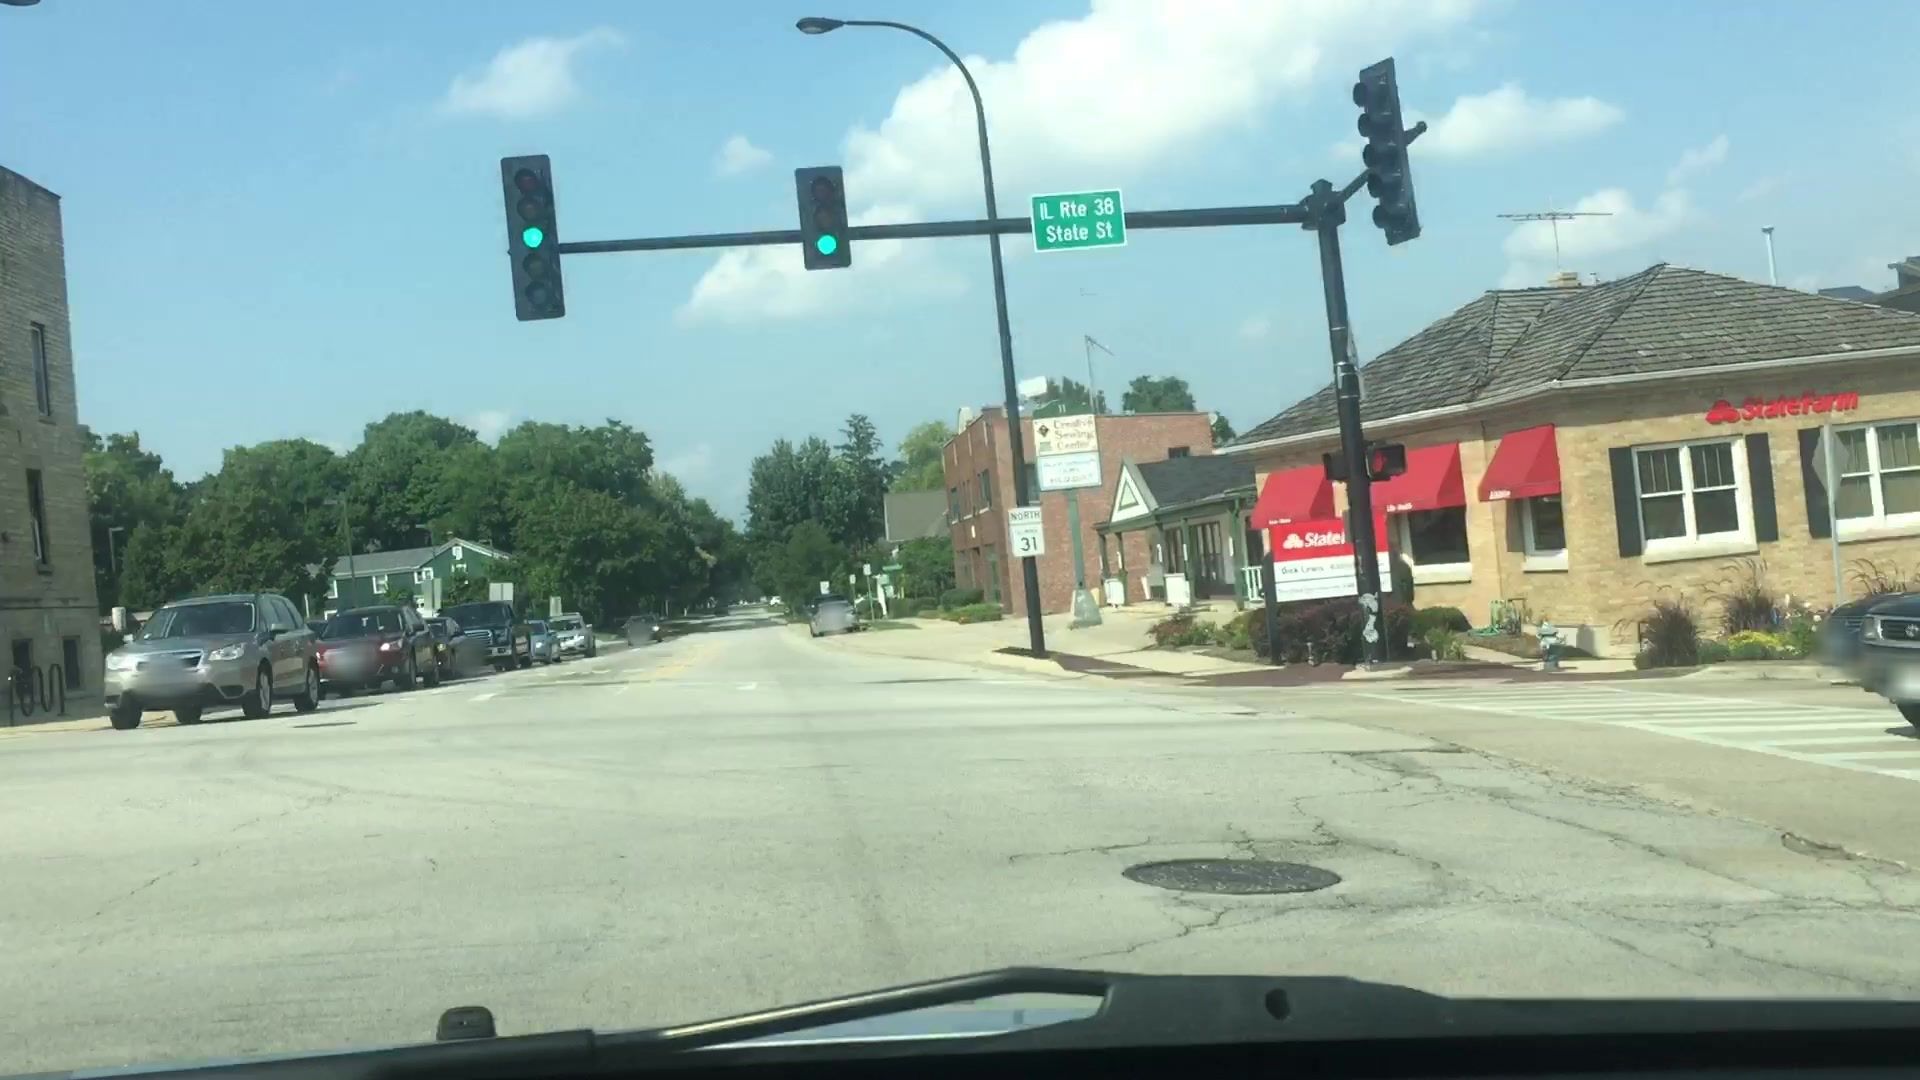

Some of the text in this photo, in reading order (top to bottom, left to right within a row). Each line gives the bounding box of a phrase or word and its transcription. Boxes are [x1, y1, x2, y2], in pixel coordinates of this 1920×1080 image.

[1039, 197, 1114, 220] IL Rte 38
[1046, 221, 1113, 242] State St
[1010, 511, 1040, 521] NORTH
[1020, 536, 1037, 552] 31
